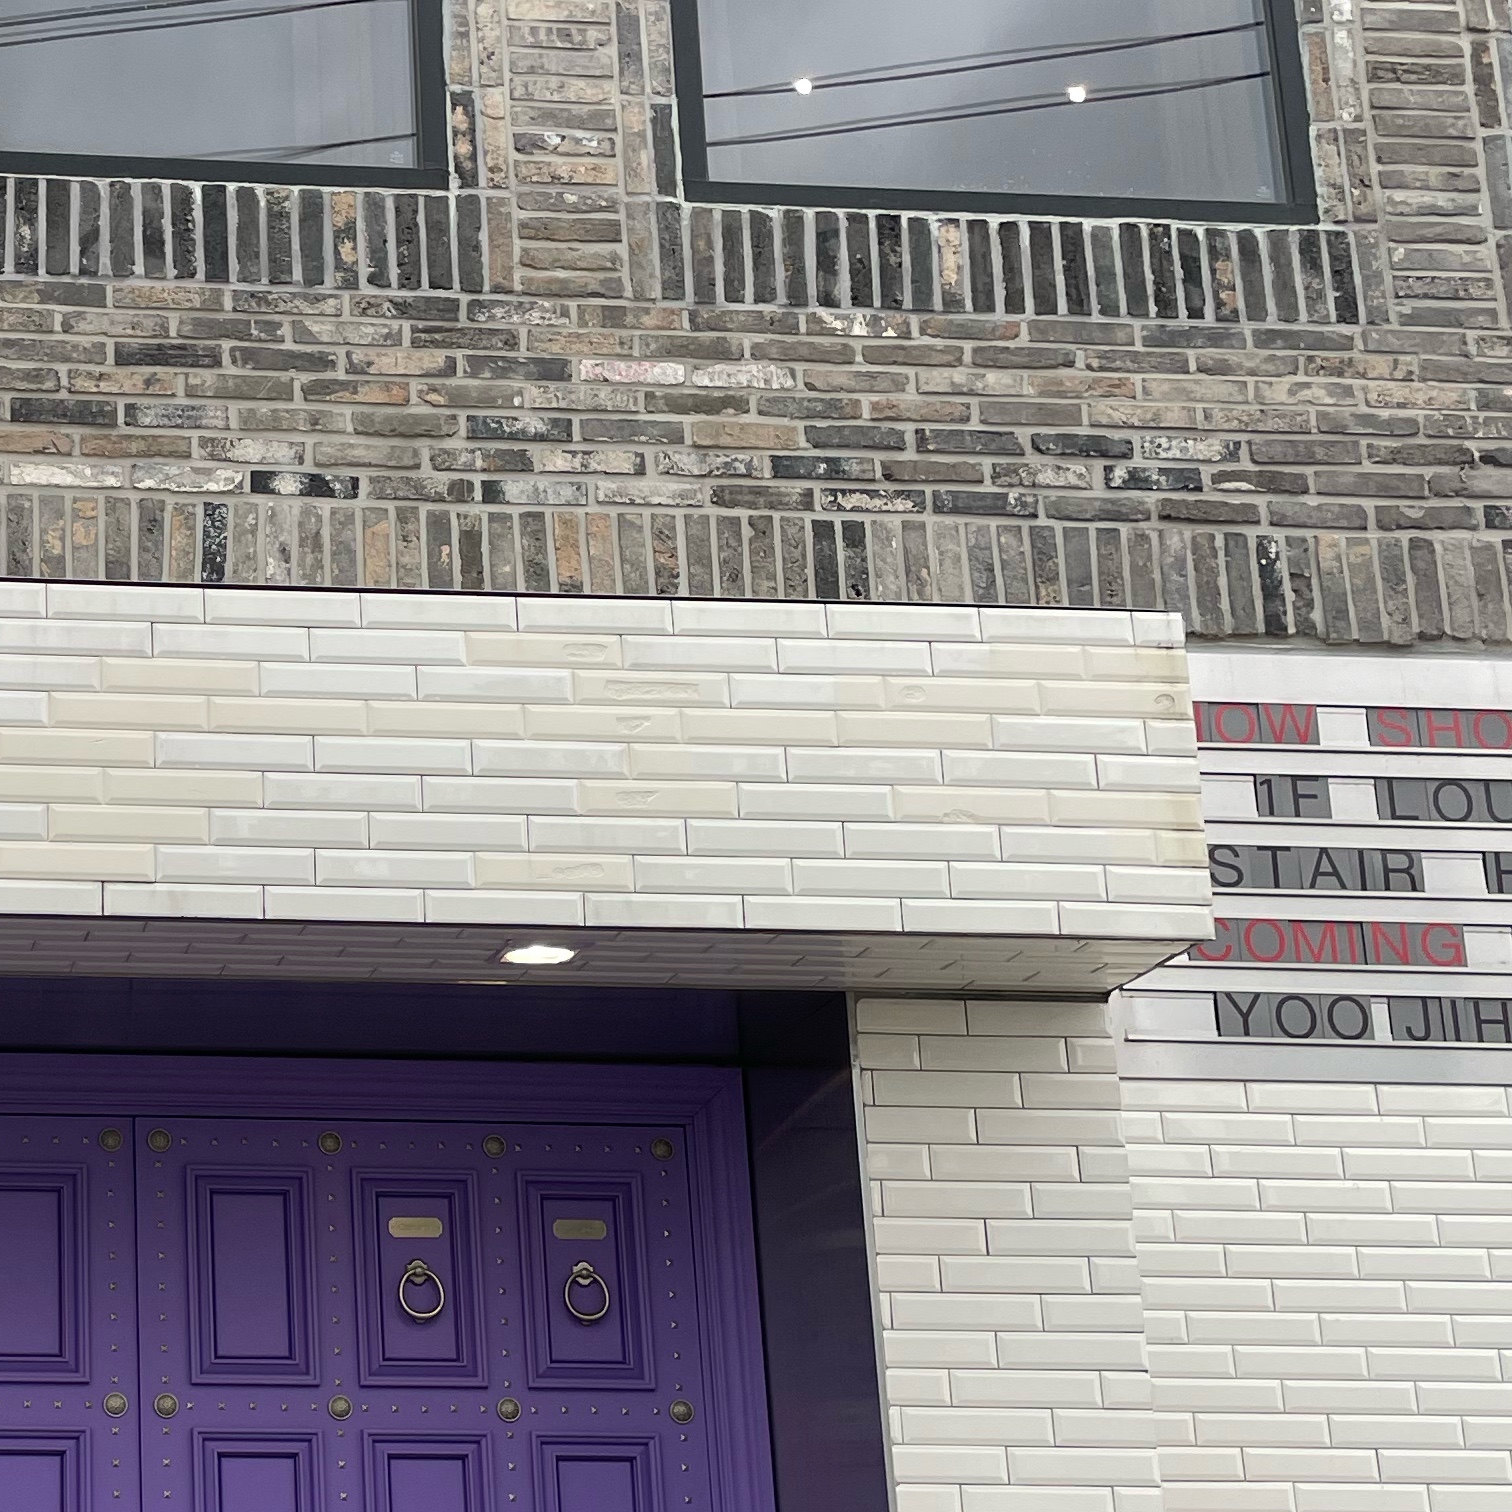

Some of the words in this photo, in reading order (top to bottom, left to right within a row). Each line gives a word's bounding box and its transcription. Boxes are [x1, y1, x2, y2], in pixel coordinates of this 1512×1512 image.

[1192, 702, 1314, 743] OW
[1258, 777, 1319, 817] 1F
[1208, 845, 1419, 892] STAIR
[1196, 918, 1464, 966] COMING
[1225, 992, 1370, 1040] YOO
[1405, 998, 1512, 1043] JIH
